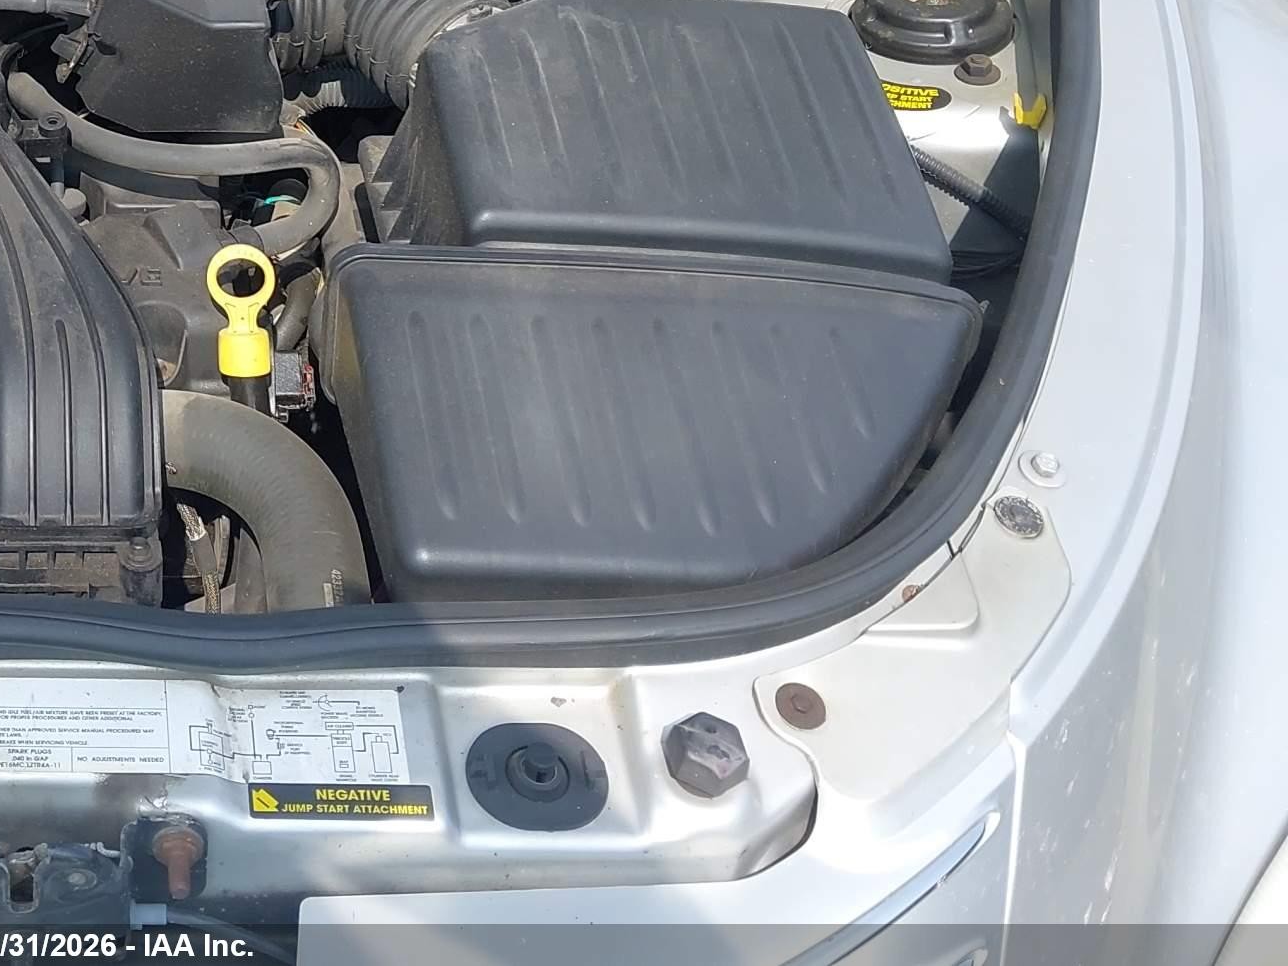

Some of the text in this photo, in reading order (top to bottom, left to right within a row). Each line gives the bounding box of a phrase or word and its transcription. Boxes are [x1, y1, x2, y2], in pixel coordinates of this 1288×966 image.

[315, 788, 391, 802] NEGATIVE
[281, 804, 428, 816] JUMP START ATTACHMENT
